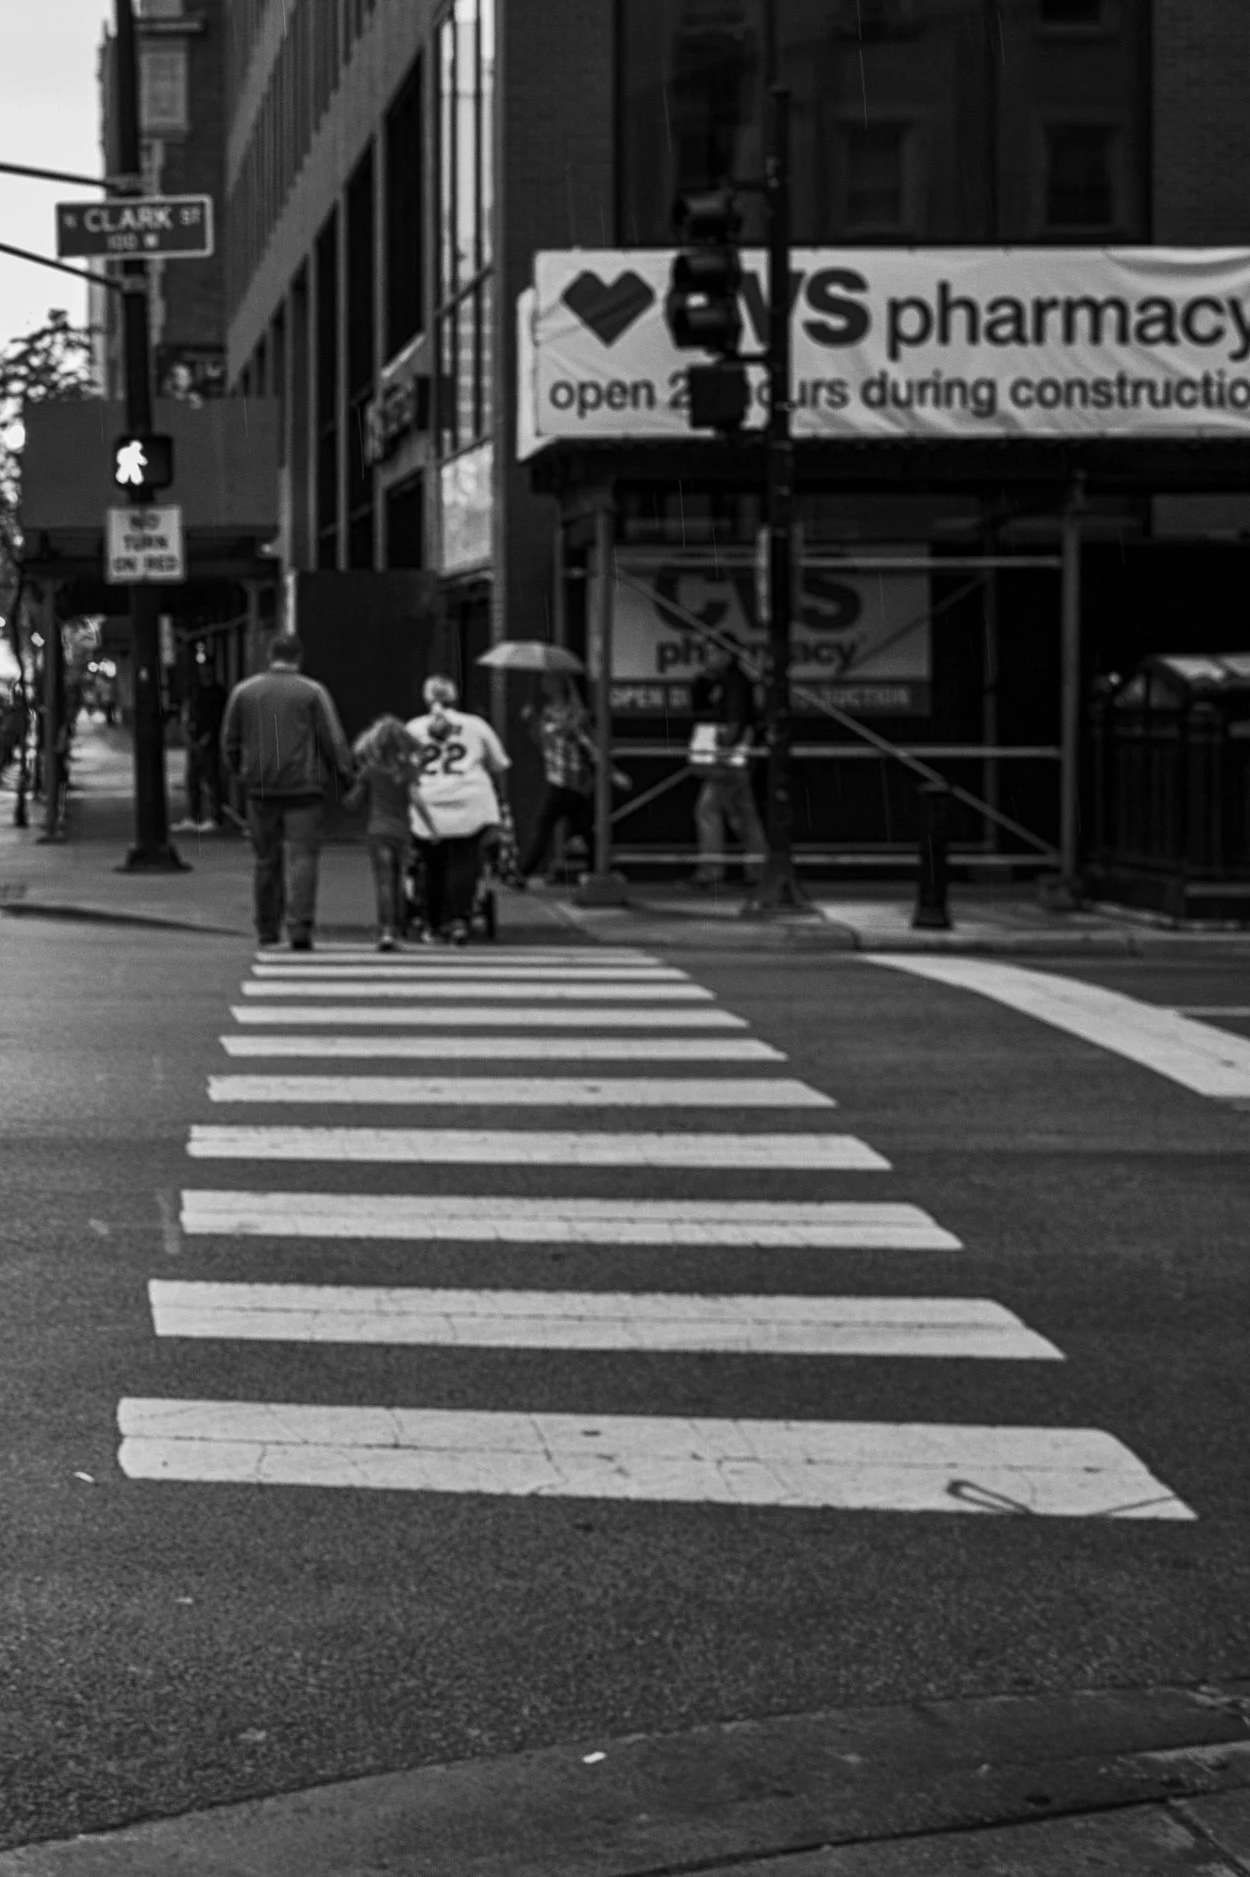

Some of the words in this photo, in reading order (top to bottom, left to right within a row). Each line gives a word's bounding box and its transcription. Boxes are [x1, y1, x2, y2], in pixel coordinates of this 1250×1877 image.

[83, 205, 173, 233] CLARK
[886, 280, 1250, 362] pharmacy
[550, 375, 658, 418] open
[859, 370, 998, 417] during
[655, 636, 856, 678] phacy
[421, 743, 467, 776] 22
